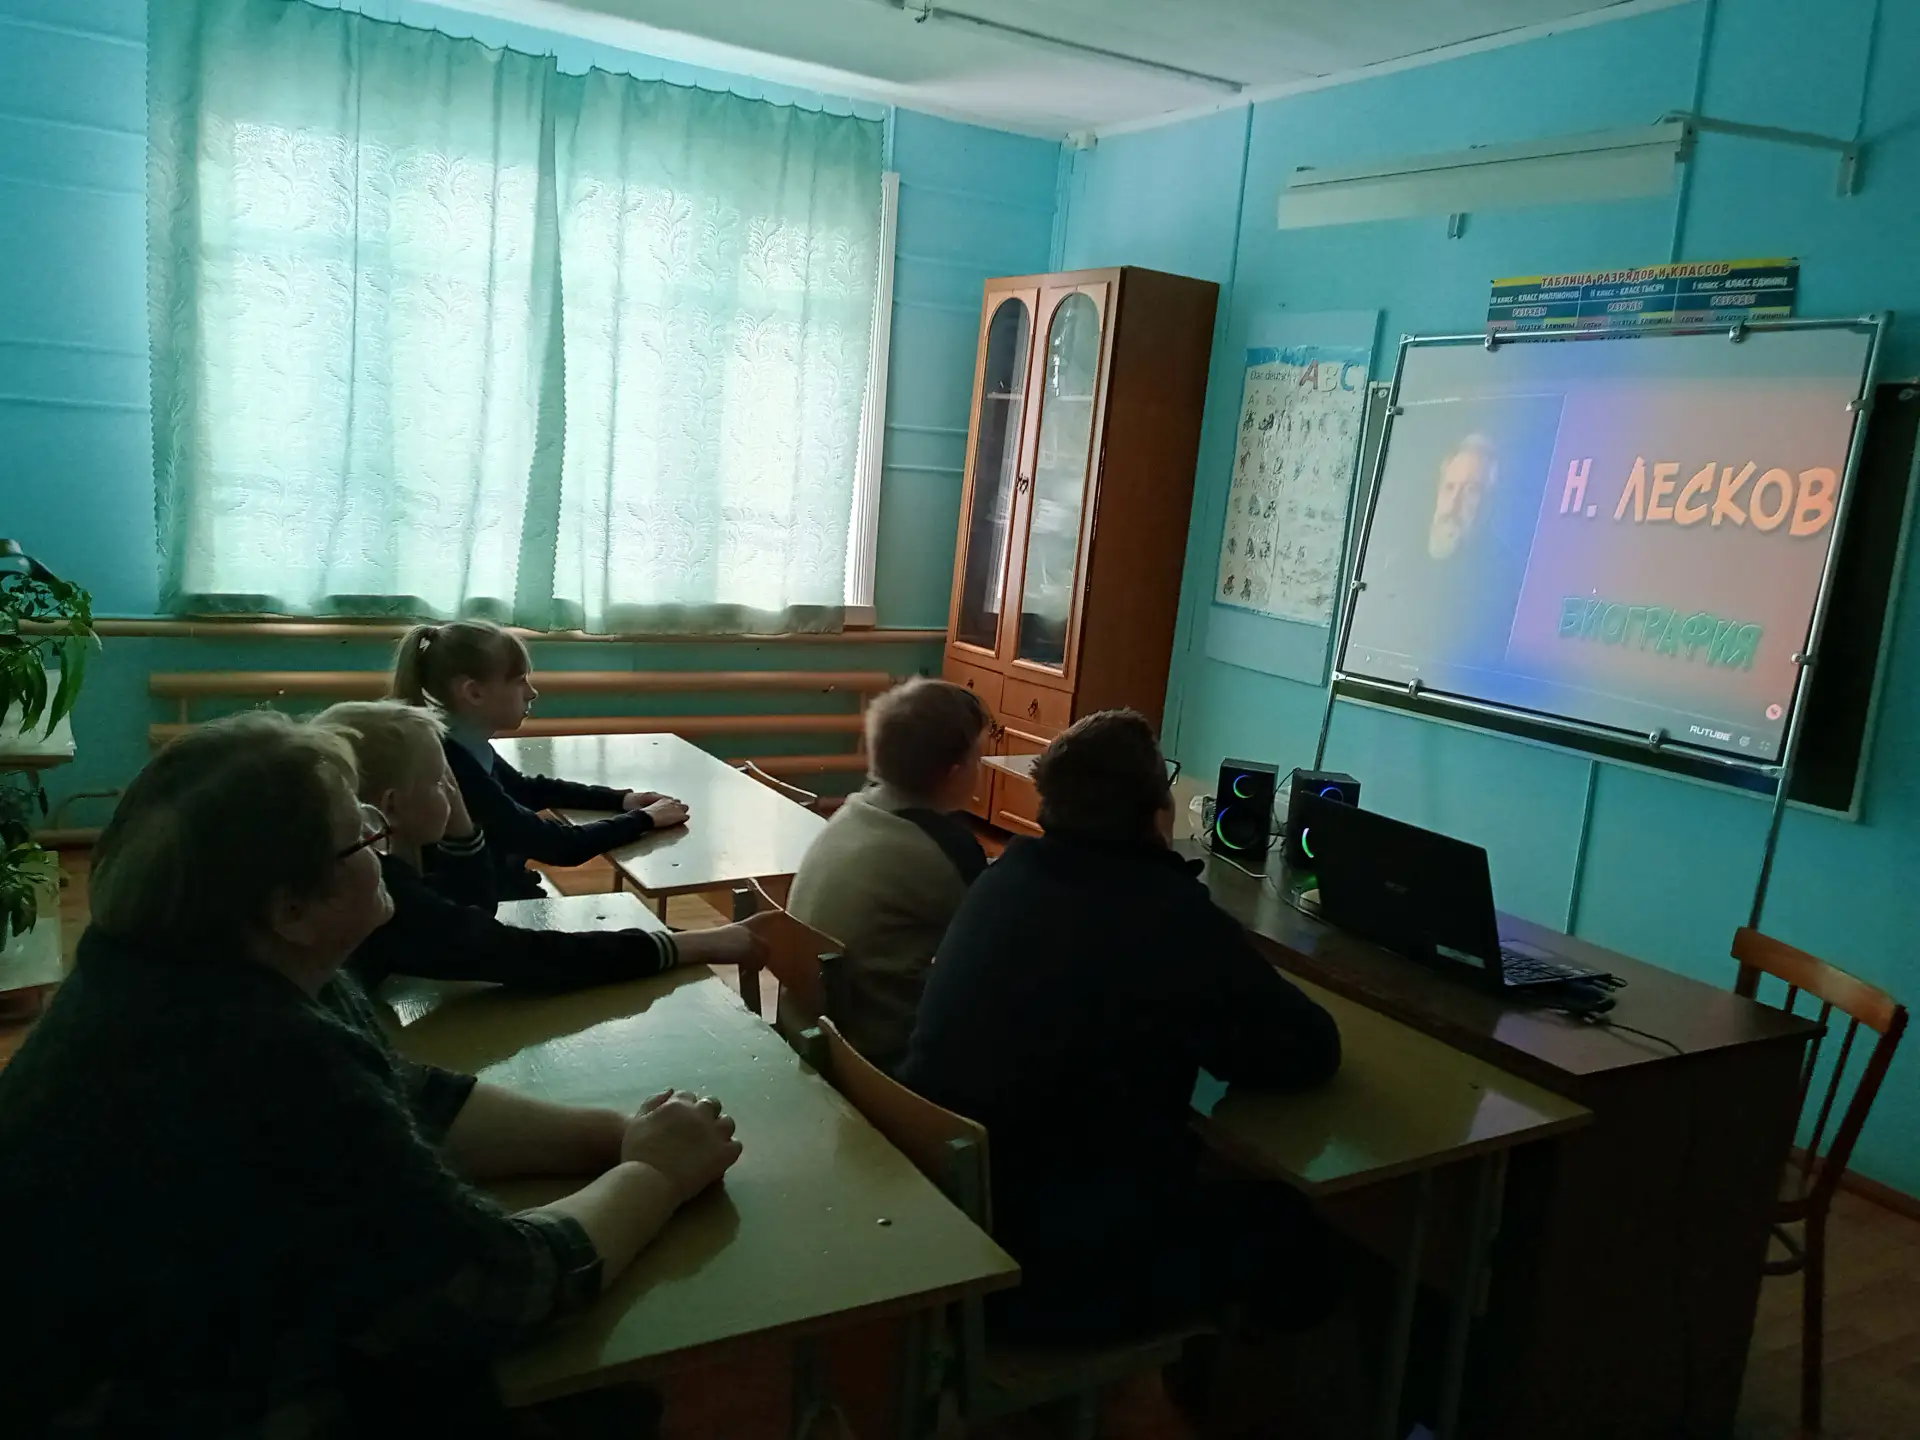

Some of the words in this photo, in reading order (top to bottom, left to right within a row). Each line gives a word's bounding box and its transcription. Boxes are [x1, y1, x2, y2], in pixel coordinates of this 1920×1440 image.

[1541, 273, 1593, 289] ТАБЛИЦА
[1595, 268, 1655, 285] РАЗРЯДОВ
[1657, 267, 1667, 280] И
[1669, 262, 1732, 278] КЛАССОВ
[1641, 283, 1665, 293] ТЫСЯЧ
[1560, 458, 1598, 518] Н.
[1613, 455, 1837, 537] ЛЕСКОВ
[1559, 597, 1764, 671] БИОГРАФИЯ
[1690, 725, 1732, 741] RUTUBE
